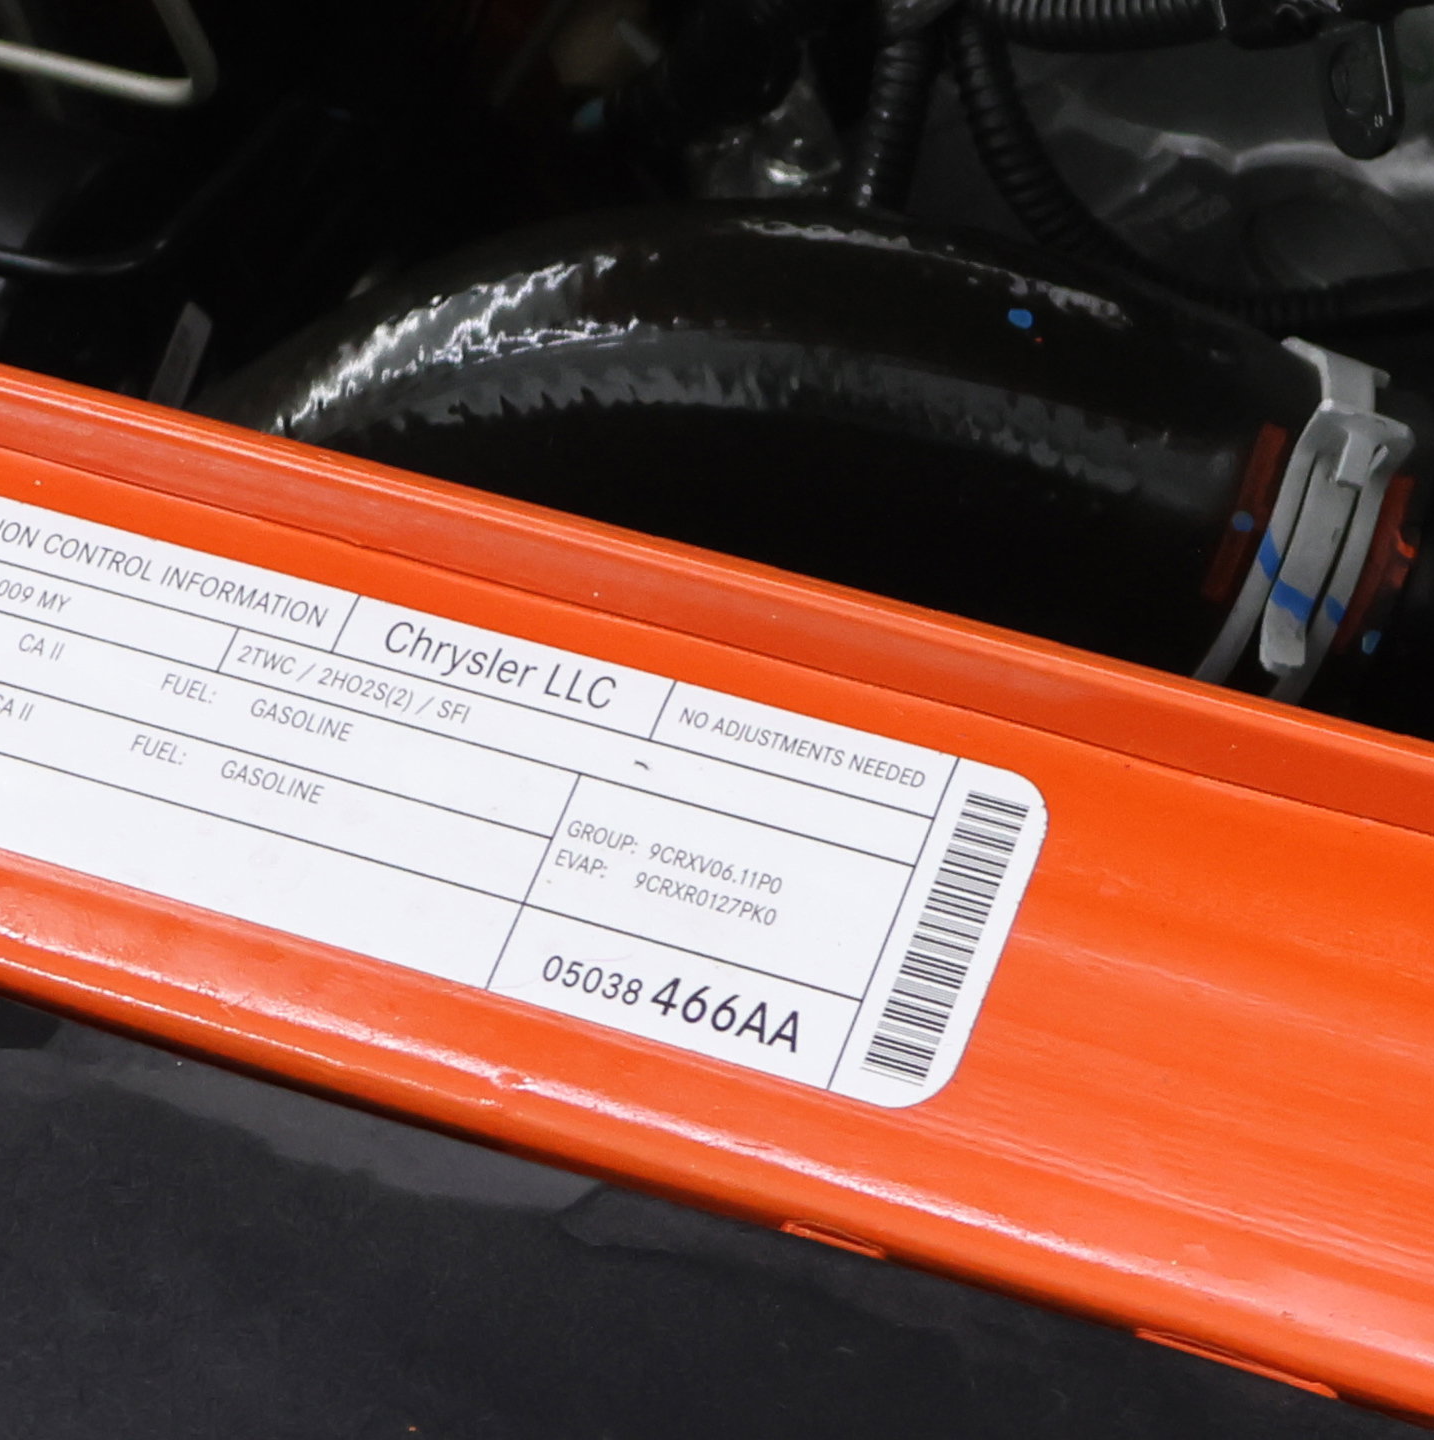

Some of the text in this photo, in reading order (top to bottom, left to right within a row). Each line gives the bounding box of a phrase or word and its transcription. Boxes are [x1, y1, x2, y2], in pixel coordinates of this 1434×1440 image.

[36, 589, 72, 613] MY
[43, 533, 152, 582] CONTROL
[159, 565, 329, 628] INFORMATION
[18, 633, 45, 657] CA
[160, 673, 216, 704] FUEL:
[250, 698, 354, 742] GASOLINE
[236, 644, 297, 675] 2TWC
[296, 663, 316, 682] /
[415, 696, 435, 715] /
[436, 699, 471, 724] SFI
[384, 621, 617, 709] Chrysler LLC
[130, 733, 187, 766] FUEL:
[220, 759, 325, 805] GASOLINE
[679, 707, 926, 788] NO ADJUSTMENTS NEEDED
[554, 848, 608, 879] EVAP:
[566, 820, 638, 854] GROUP:
